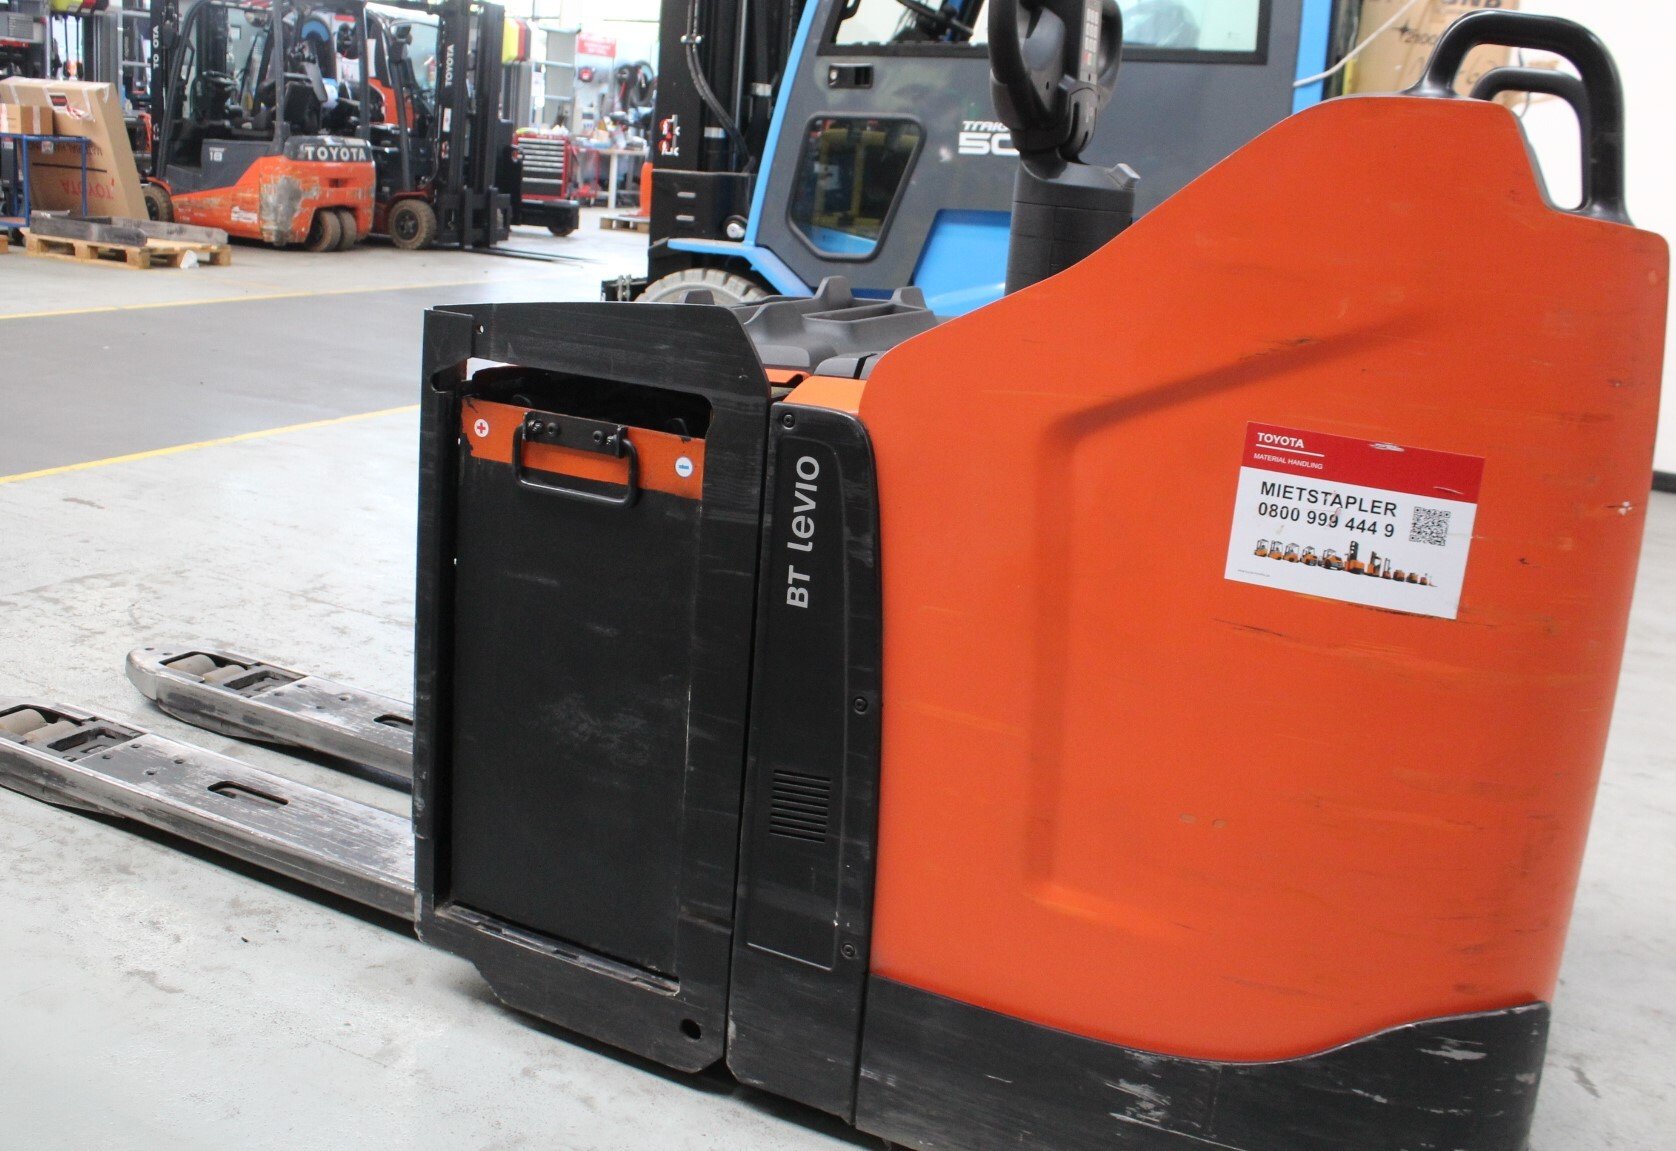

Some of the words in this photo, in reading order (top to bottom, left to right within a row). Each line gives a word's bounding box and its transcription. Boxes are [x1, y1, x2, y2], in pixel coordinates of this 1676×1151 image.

[445, 44, 454, 86] TOYOTA
[304, 145, 366, 161] TOYOTA
[1257, 432, 1304, 449] TOYOTA
[1254, 452, 1287, 464] MATERIAL
[1287, 458, 1323, 470] HANDLING
[1260, 481, 1397, 517] MIETSTAPLER
[1258, 501, 1300, 522] 0800
[1306, 510, 1339, 528] 999
[1345, 517, 1377, 534] 444
[1384, 523, 1394, 537] 9
[786, 564, 811, 609] BT
